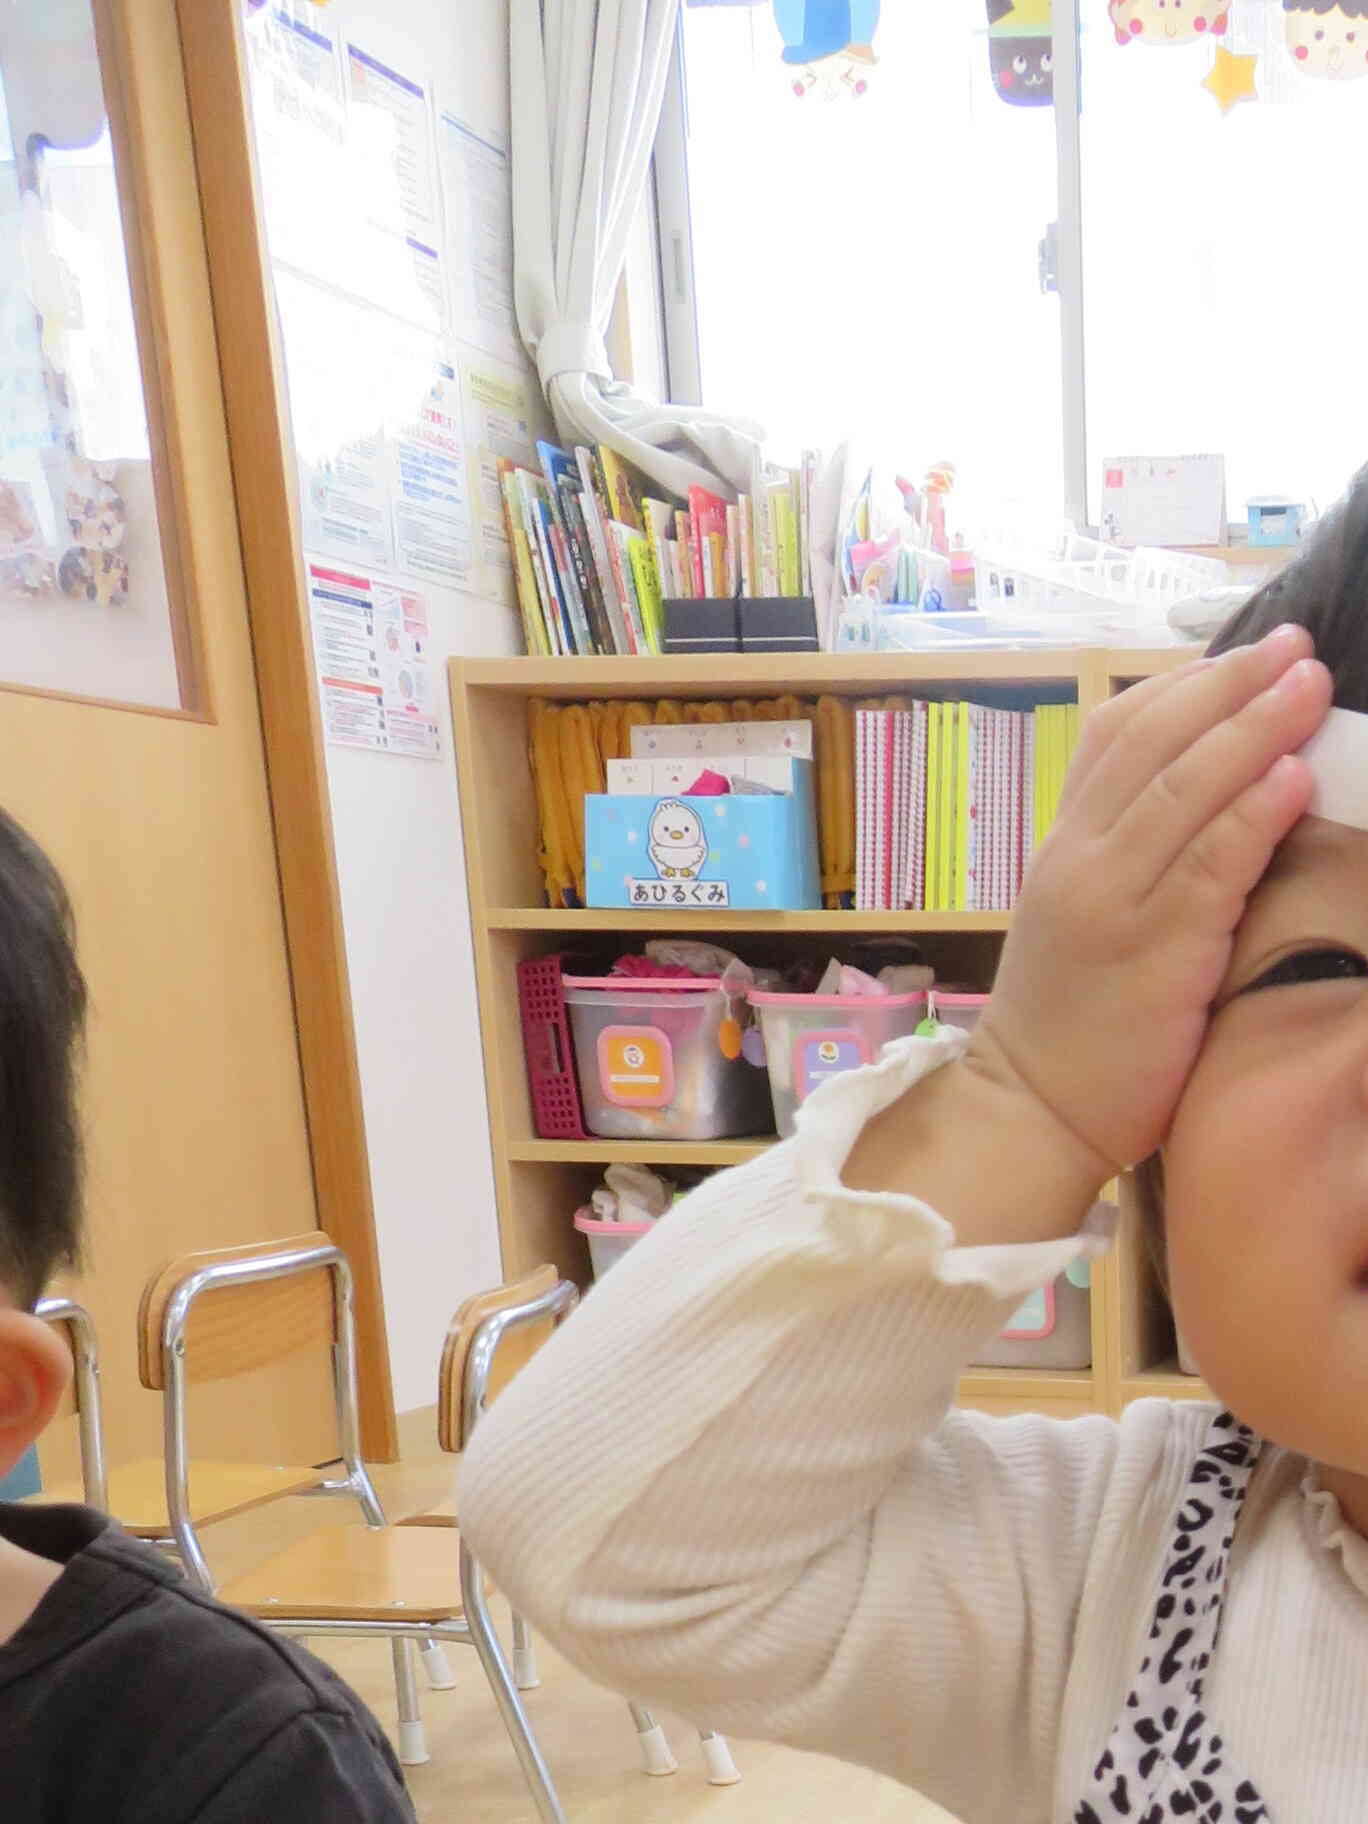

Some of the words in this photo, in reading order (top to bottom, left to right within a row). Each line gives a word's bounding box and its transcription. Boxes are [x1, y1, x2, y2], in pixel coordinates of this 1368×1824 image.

[633, 883, 725, 902] あひるぐみ
